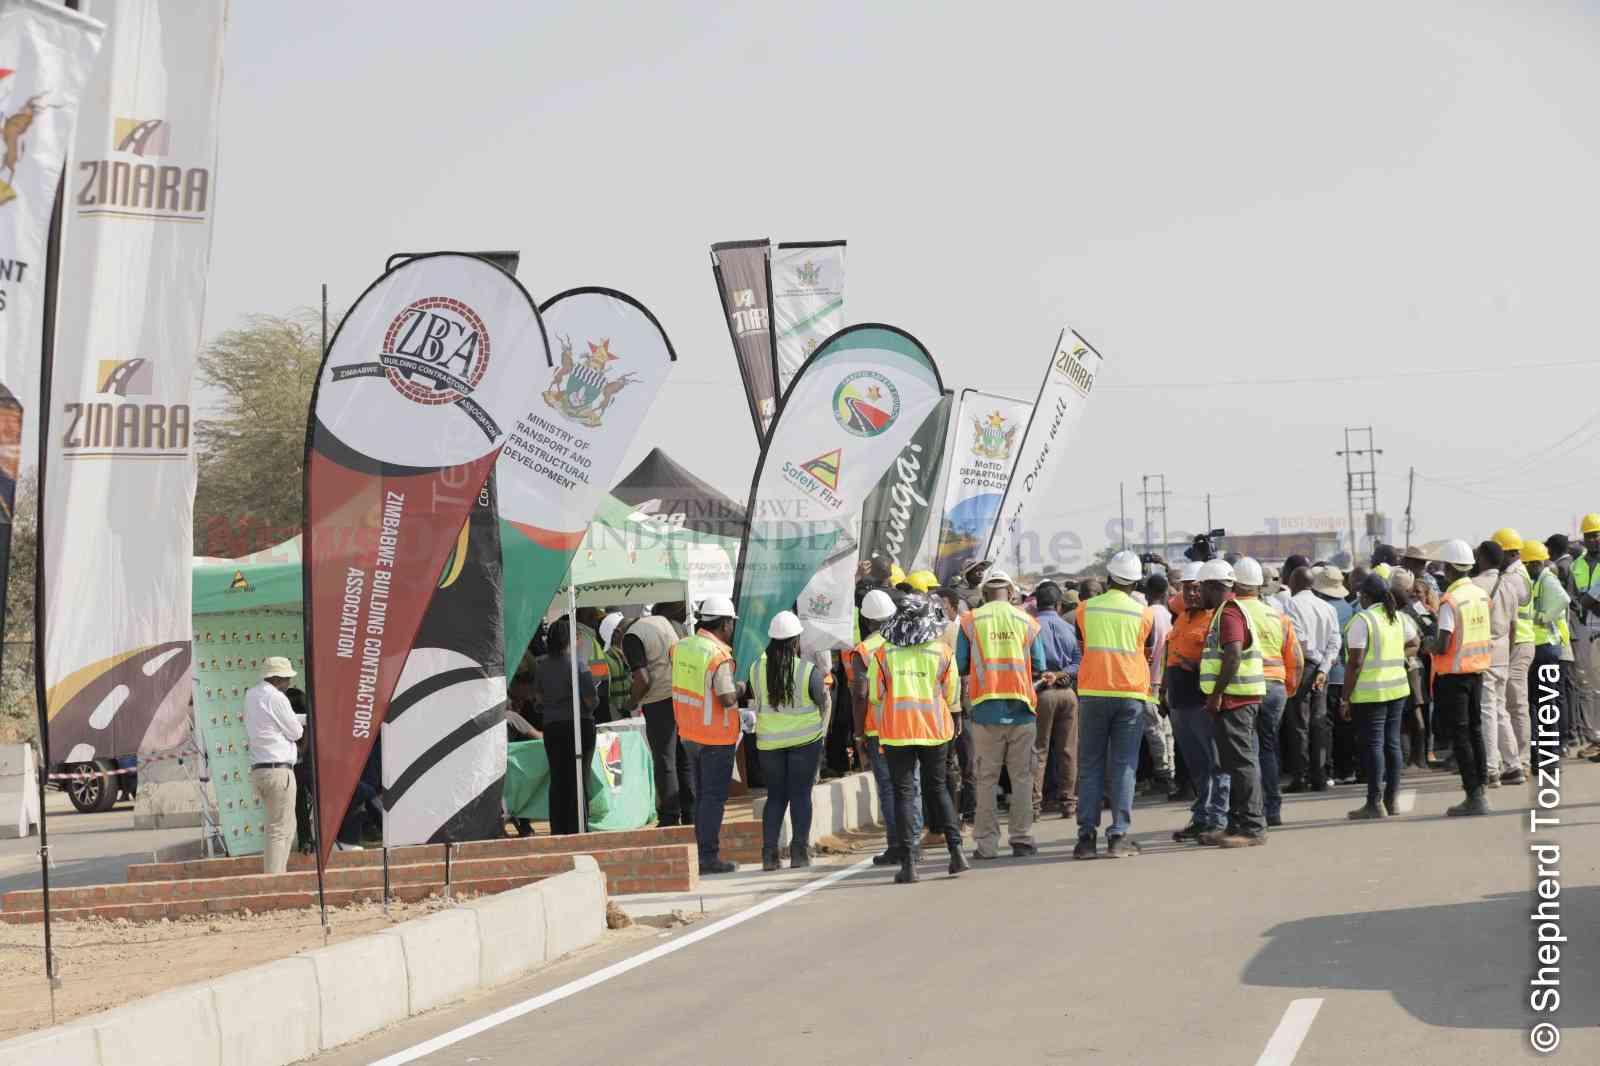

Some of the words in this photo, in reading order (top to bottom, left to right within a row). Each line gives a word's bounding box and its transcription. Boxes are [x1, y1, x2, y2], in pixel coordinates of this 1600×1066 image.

[77, 160, 209, 212] ZINARA
[1055, 350, 1094, 392] ZINARA
[340, 366, 379, 378] ZIMBABWE
[384, 356, 417, 370] BUILDING
[418, 363, 469, 393] CONTRACTORS
[462, 398, 497, 437] ASSOCIATION
[61, 402, 190, 450] ZINARA
[527, 412, 574, 443] MINISTRY
[574, 439, 591, 450] OF
[503, 446, 577, 491] DEVELOPMENT
[570, 452, 592, 468] AND
[959, 467, 1009, 481] DEPARTMEN
[782, 461, 819, 491] Safety
[819, 487, 843, 509] First
[376, 490, 405, 568] ZIMBABWE
[336, 567, 365, 658] ASSOCIATION
[366, 571, 393, 636] BUILDING
[352, 638, 382, 739] CONTRACTORS
